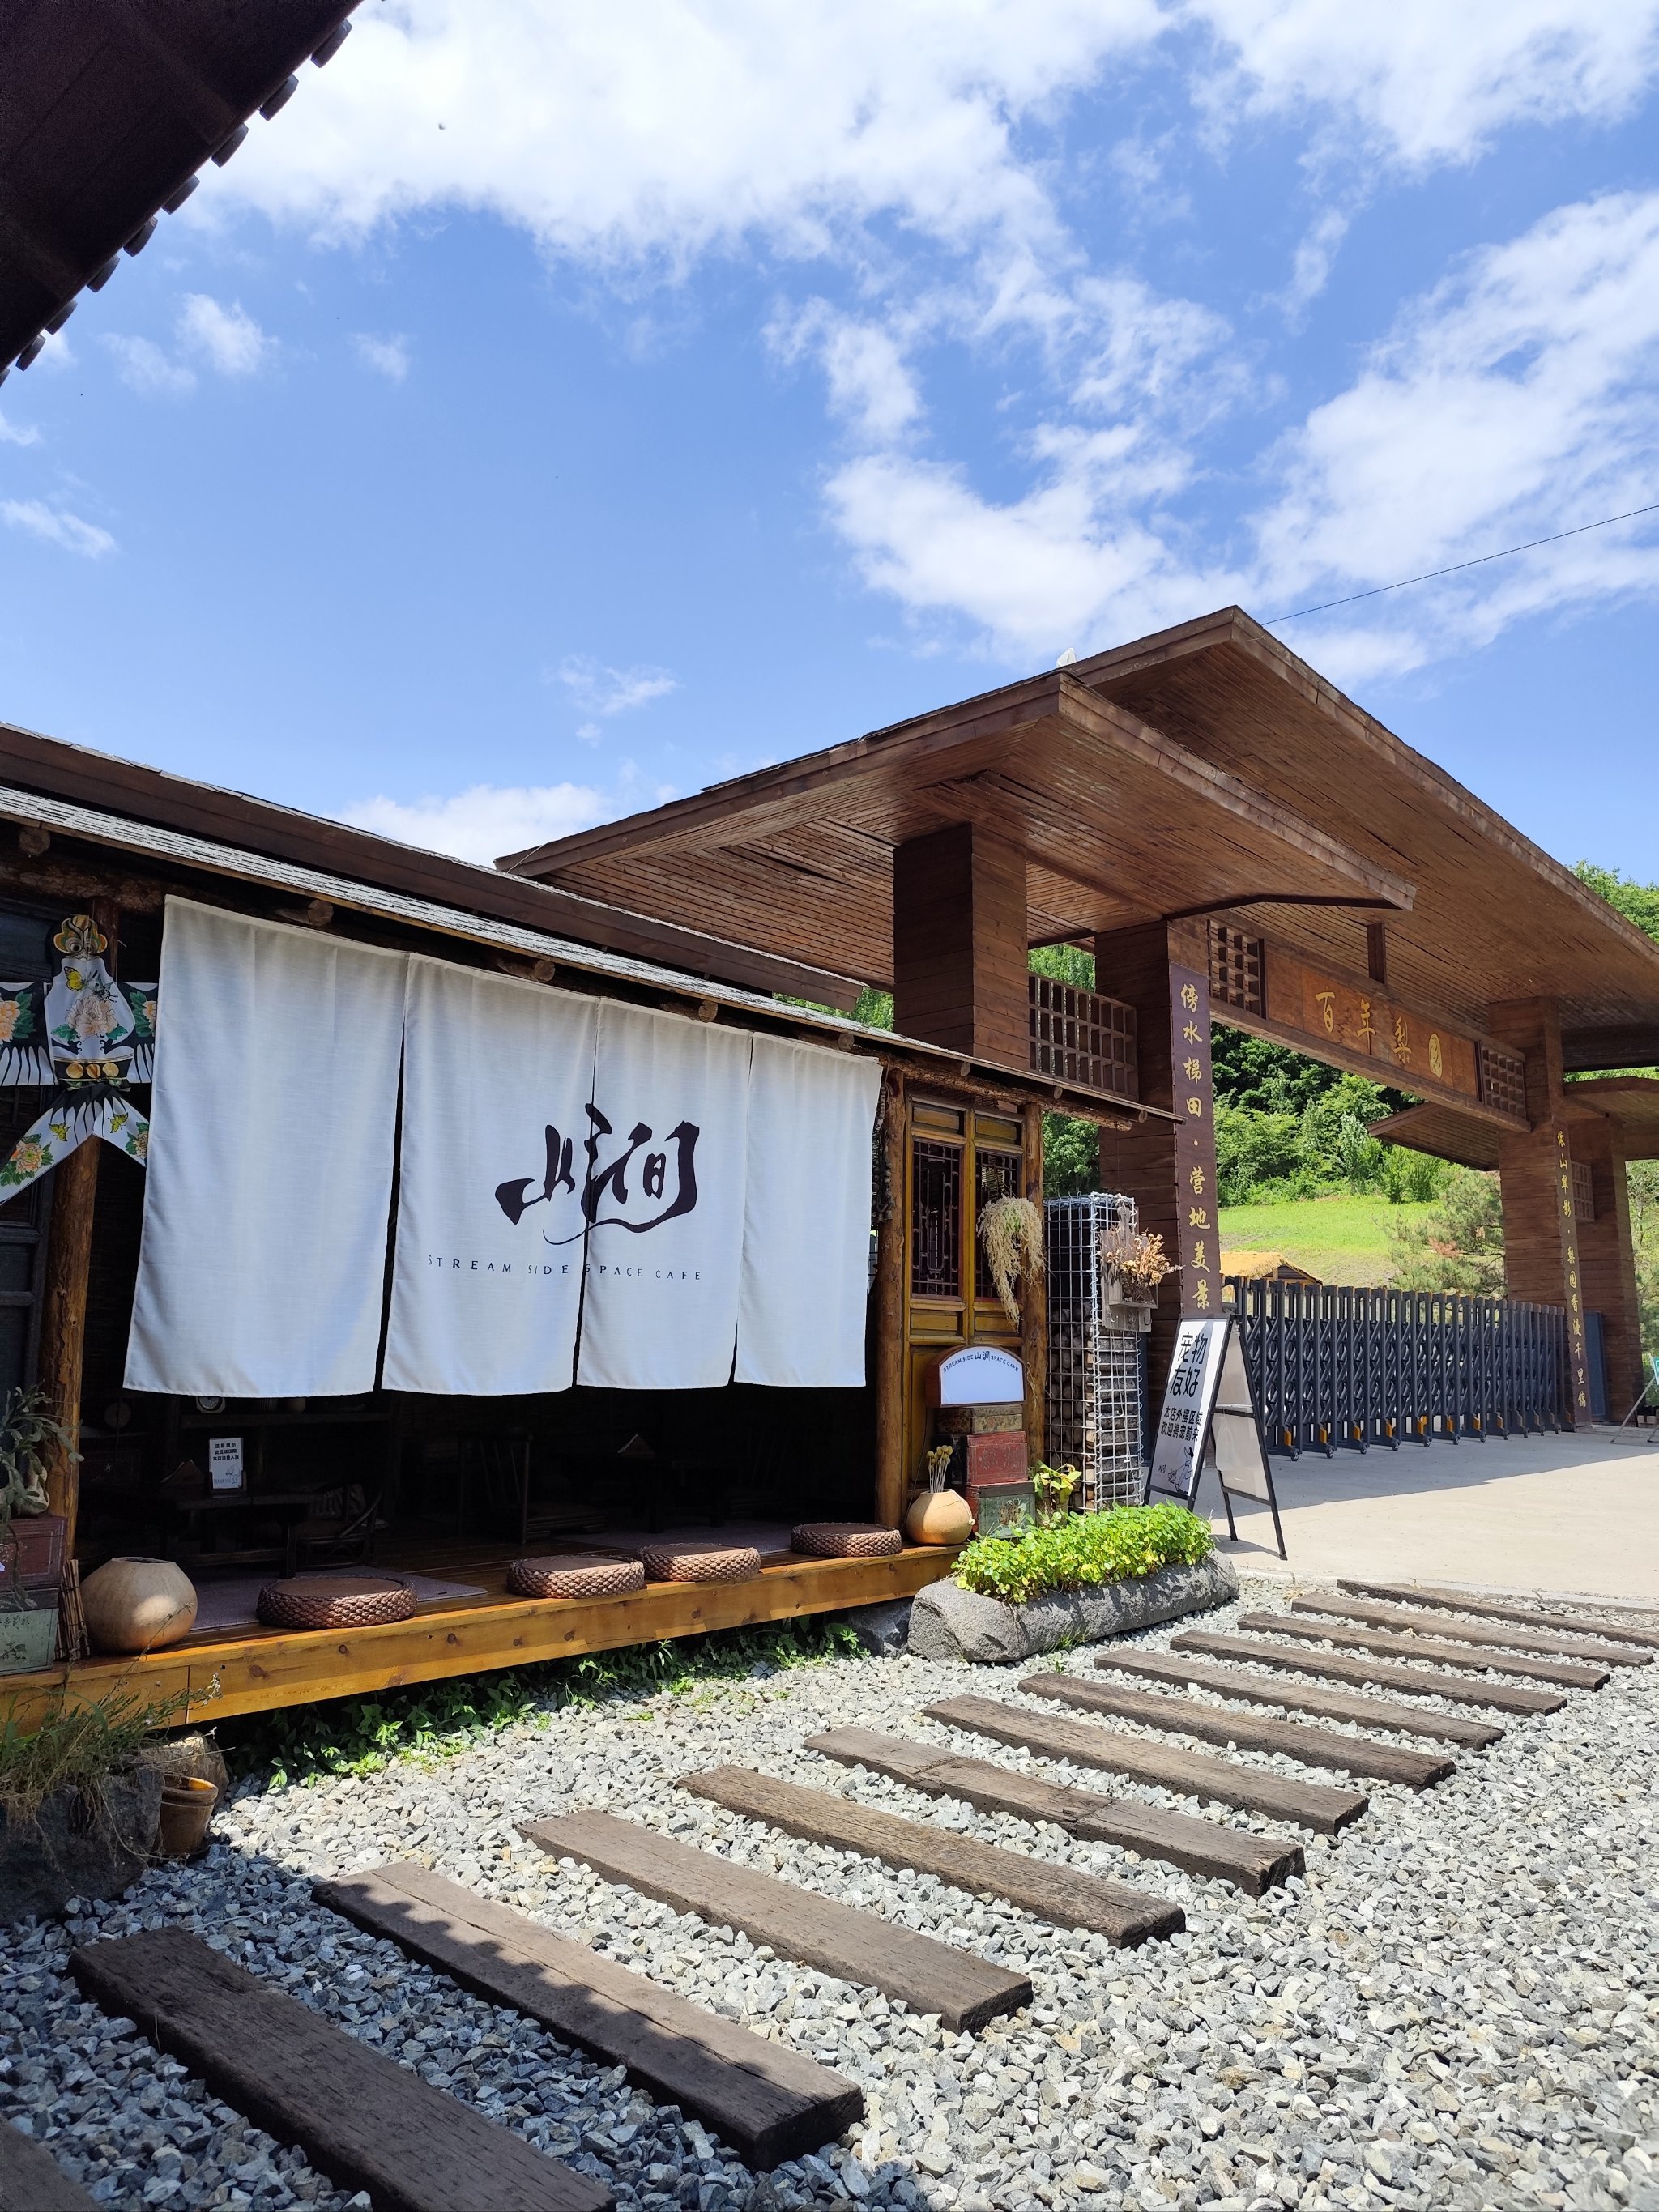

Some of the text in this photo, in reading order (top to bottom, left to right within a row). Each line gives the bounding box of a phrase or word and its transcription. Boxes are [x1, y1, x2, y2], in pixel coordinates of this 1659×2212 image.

[428, 1255, 701, 1281] STREAM SIDE SPACE CAFE
[1177, 1332, 1208, 1364] 宠物
[943, 1358, 962, 1373] STREAM
[962, 1354, 974, 1362] SIDE
[991, 1355, 1006, 1365] SPACE
[1006, 1361, 1019, 1372] CAFE
[1170, 1365, 1201, 1398] 友好
